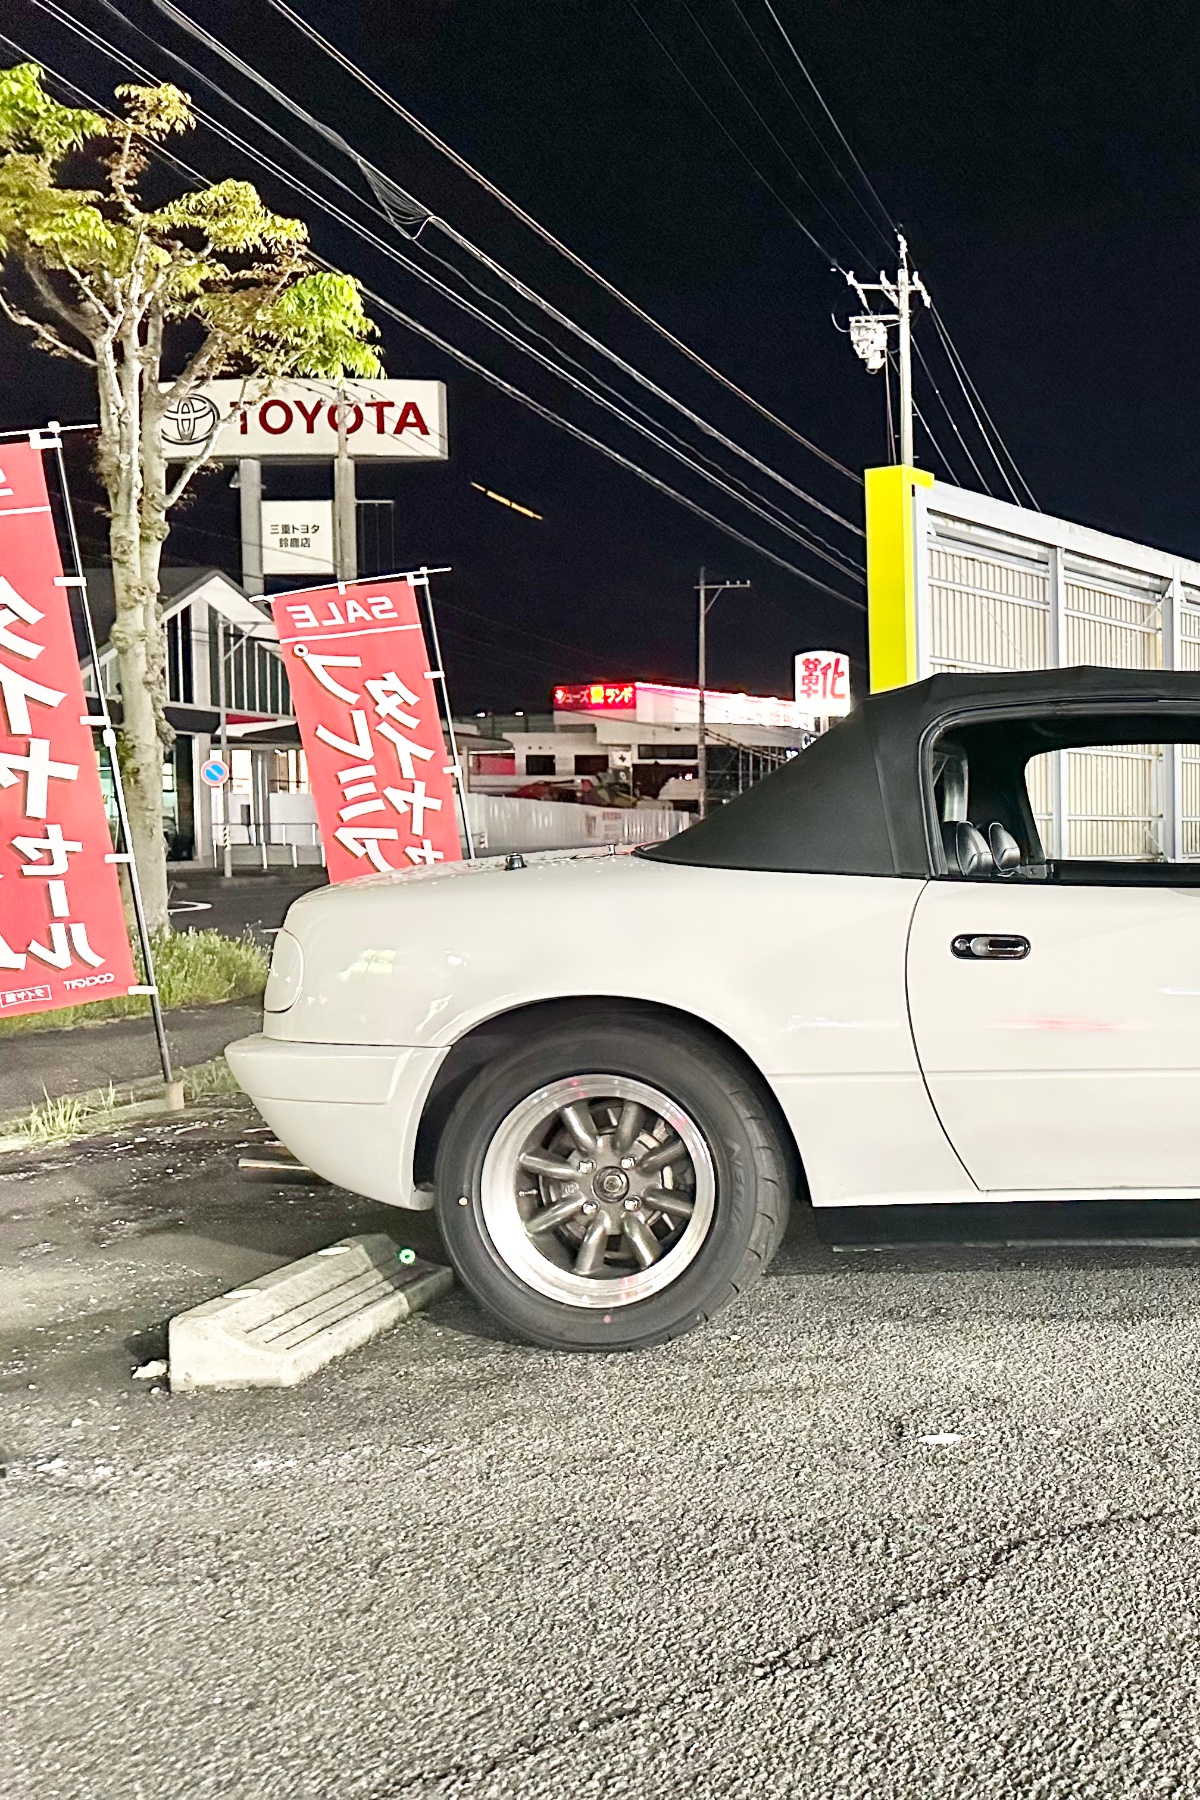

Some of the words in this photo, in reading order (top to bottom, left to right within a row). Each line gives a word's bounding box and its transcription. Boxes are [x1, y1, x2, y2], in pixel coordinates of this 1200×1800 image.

[230, 399, 430, 435] TOYOTA
[270, 524, 320, 534] 三重トヨタ
[799, 658, 847, 699] 靴
